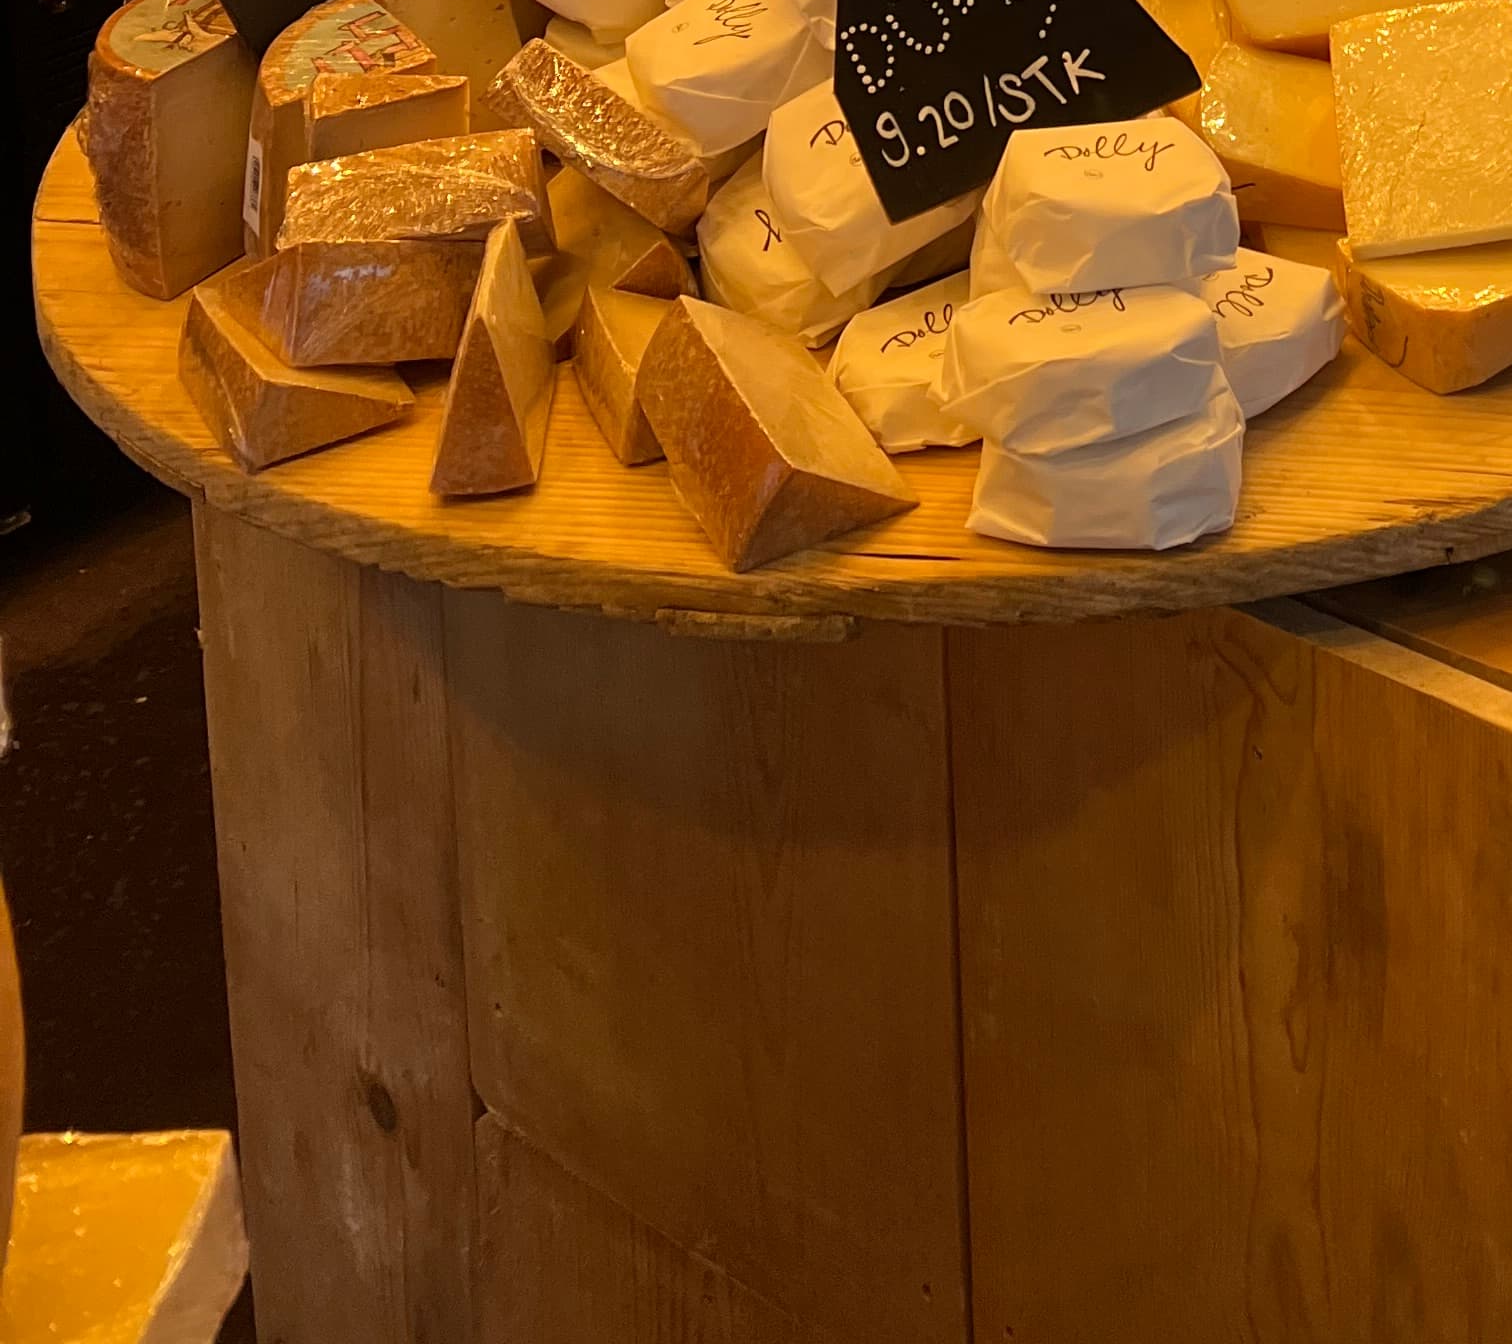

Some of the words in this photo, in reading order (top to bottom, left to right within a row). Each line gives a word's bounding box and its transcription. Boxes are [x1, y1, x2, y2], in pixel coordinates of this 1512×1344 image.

[875, 47, 1107, 168] 9.20/STK
[1043, 132, 1176, 172] Dolly
[880, 302, 955, 354] Doll
